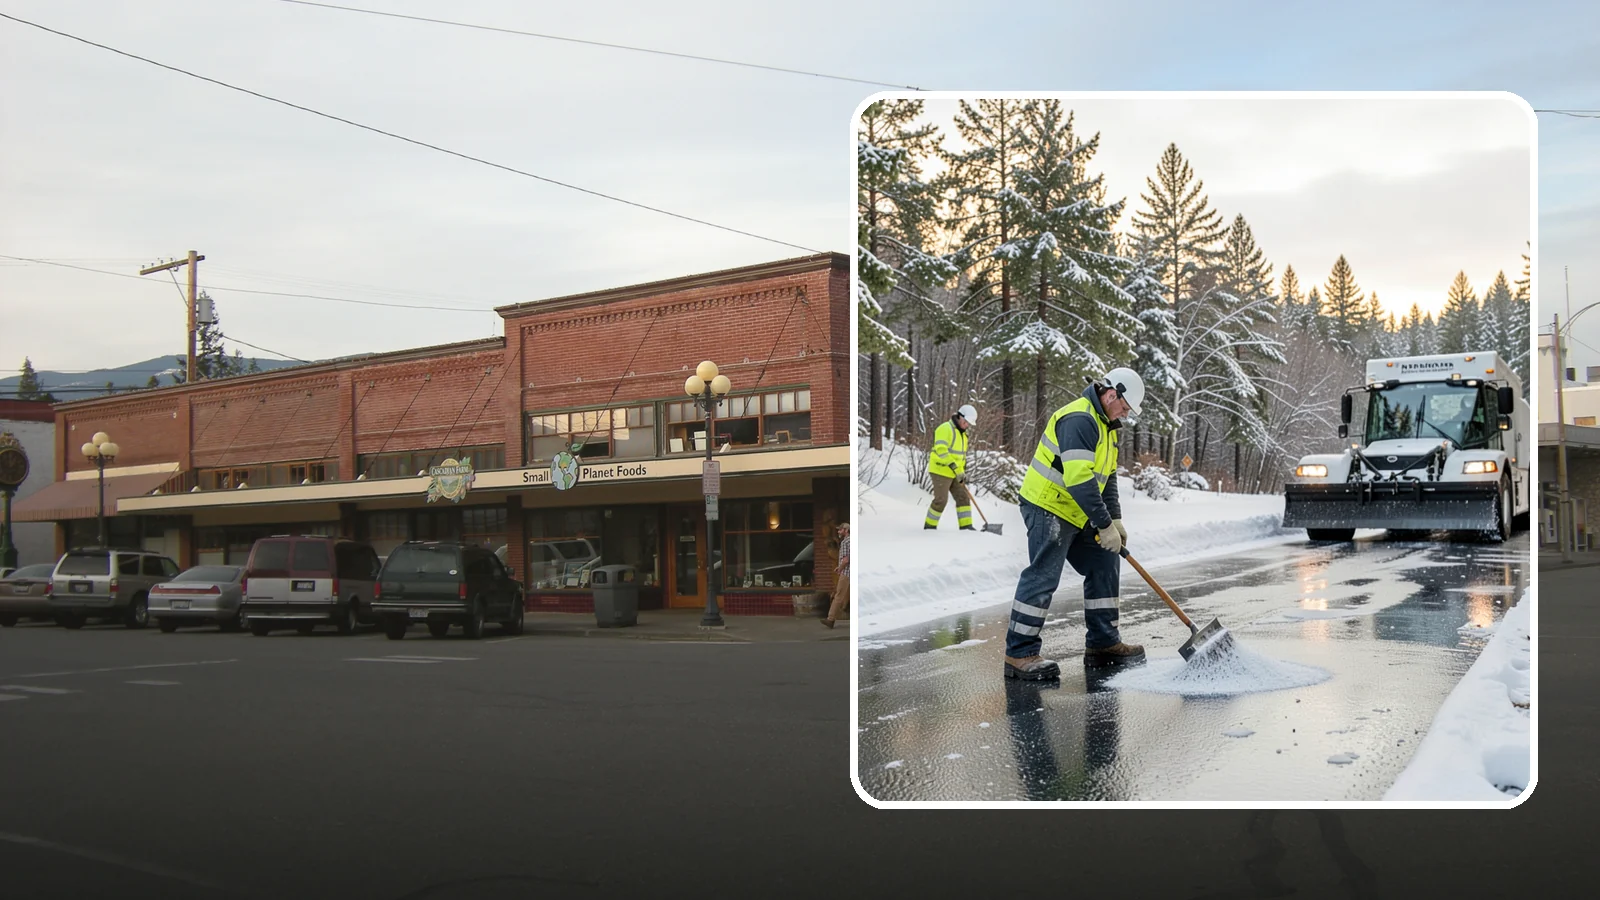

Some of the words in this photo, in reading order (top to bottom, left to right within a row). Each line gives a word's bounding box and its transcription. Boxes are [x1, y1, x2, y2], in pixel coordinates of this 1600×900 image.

[523, 471, 549, 483] Small
[582, 468, 614, 479] Planet
[616, 465, 647, 477] Foods
